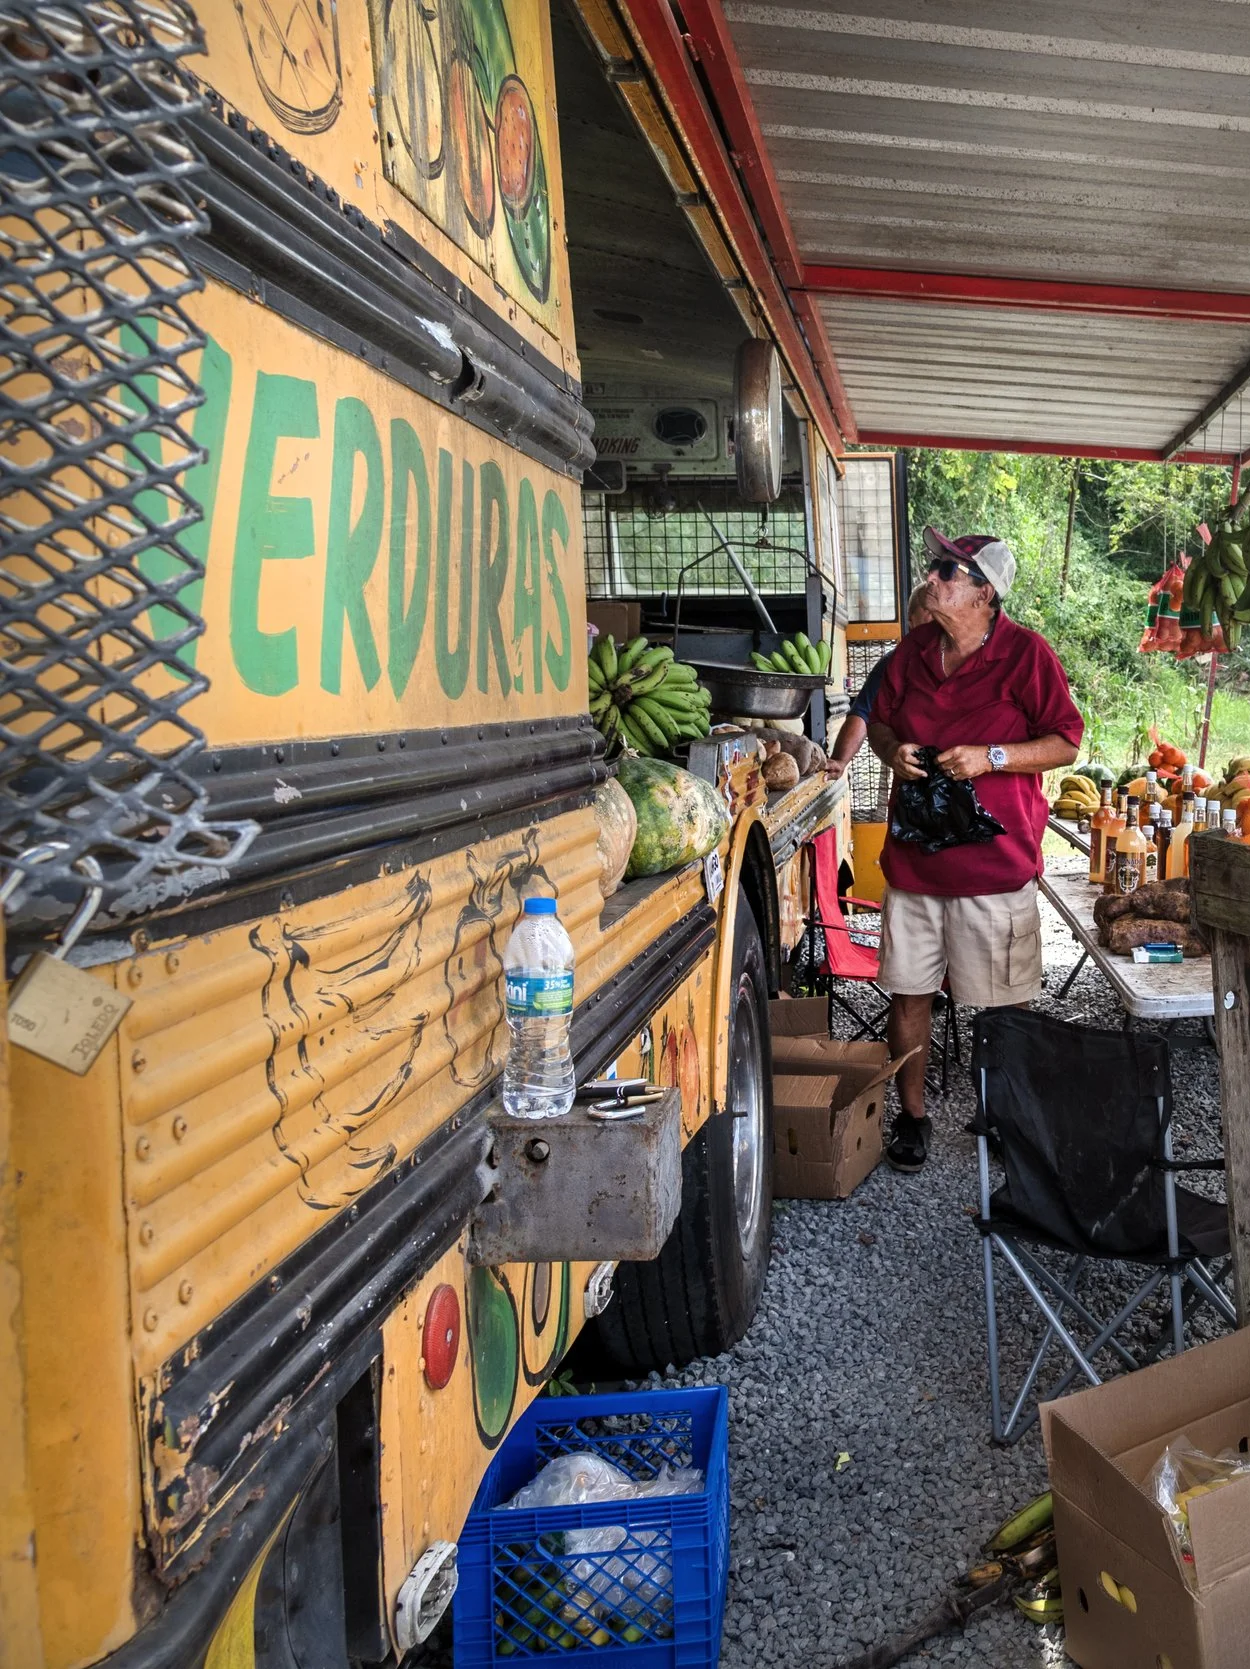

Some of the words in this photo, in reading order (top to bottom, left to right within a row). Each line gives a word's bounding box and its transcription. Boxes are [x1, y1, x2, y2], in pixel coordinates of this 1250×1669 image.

[591, 437, 641, 454] MOKING
[119, 315, 572, 701] VERDURAS
[506, 981, 528, 1002] ini
[71, 1003, 120, 1061] TOLEDO
